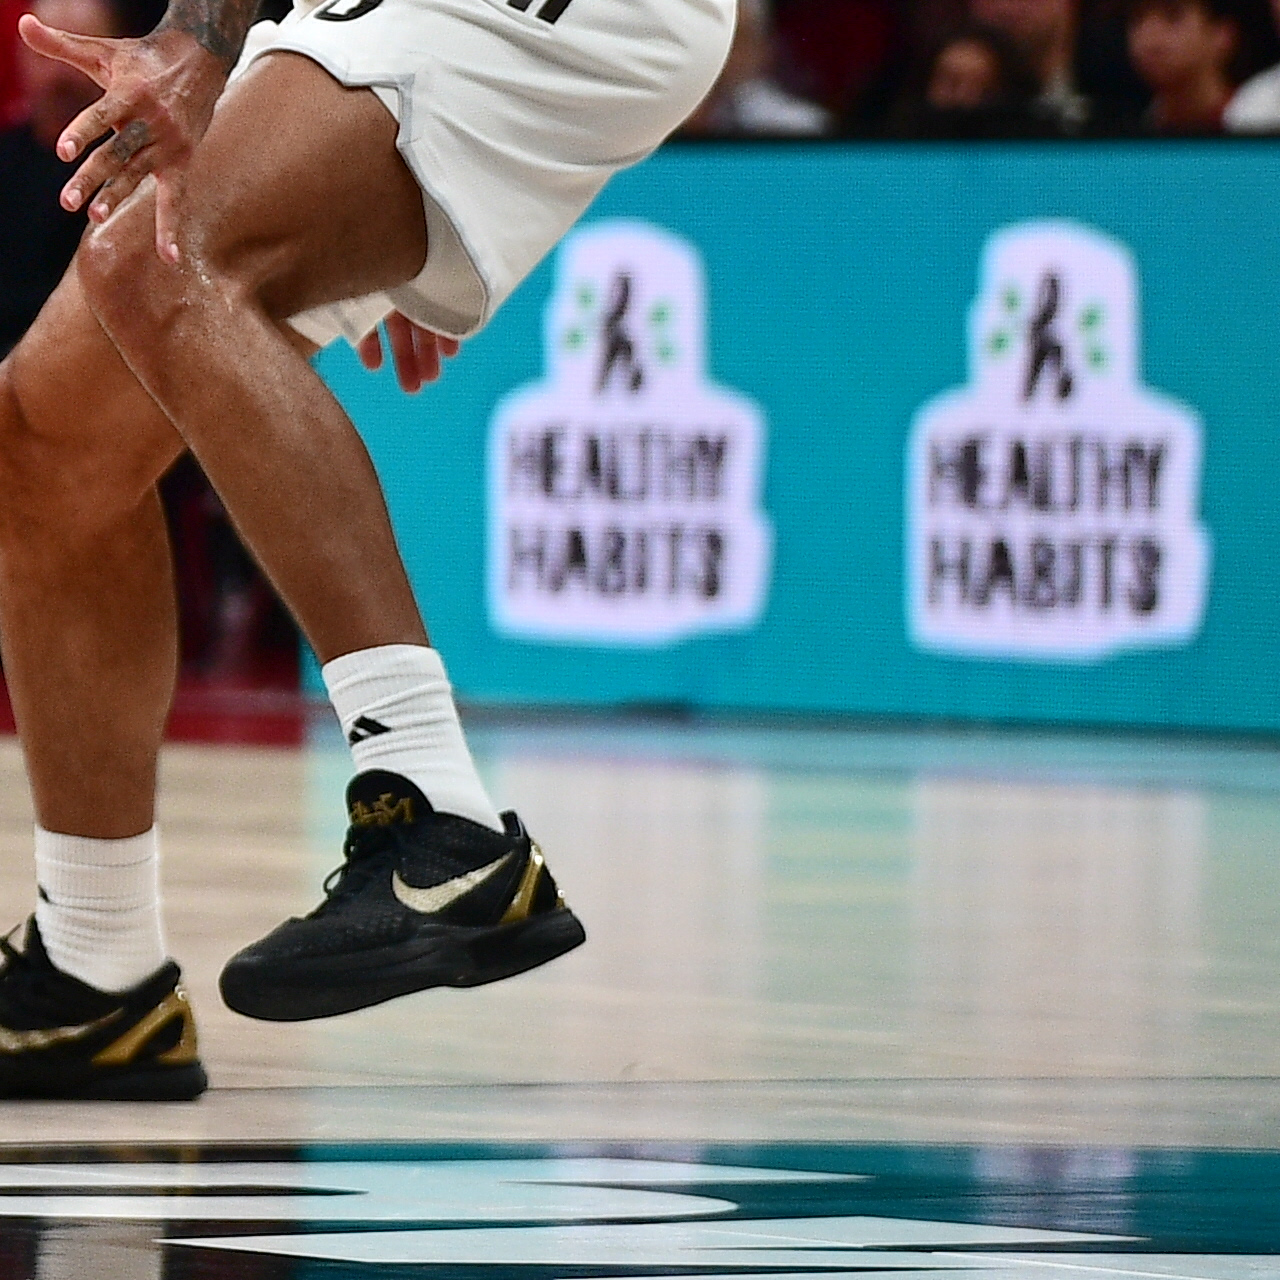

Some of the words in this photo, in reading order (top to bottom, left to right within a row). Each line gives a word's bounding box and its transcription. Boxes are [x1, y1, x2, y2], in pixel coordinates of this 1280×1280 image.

[511, 425, 727, 502] HEALTHY
[928, 431, 1166, 510] HEALTHY
[509, 524, 724, 599] HABITS
[927, 534, 1161, 614] HABITS
